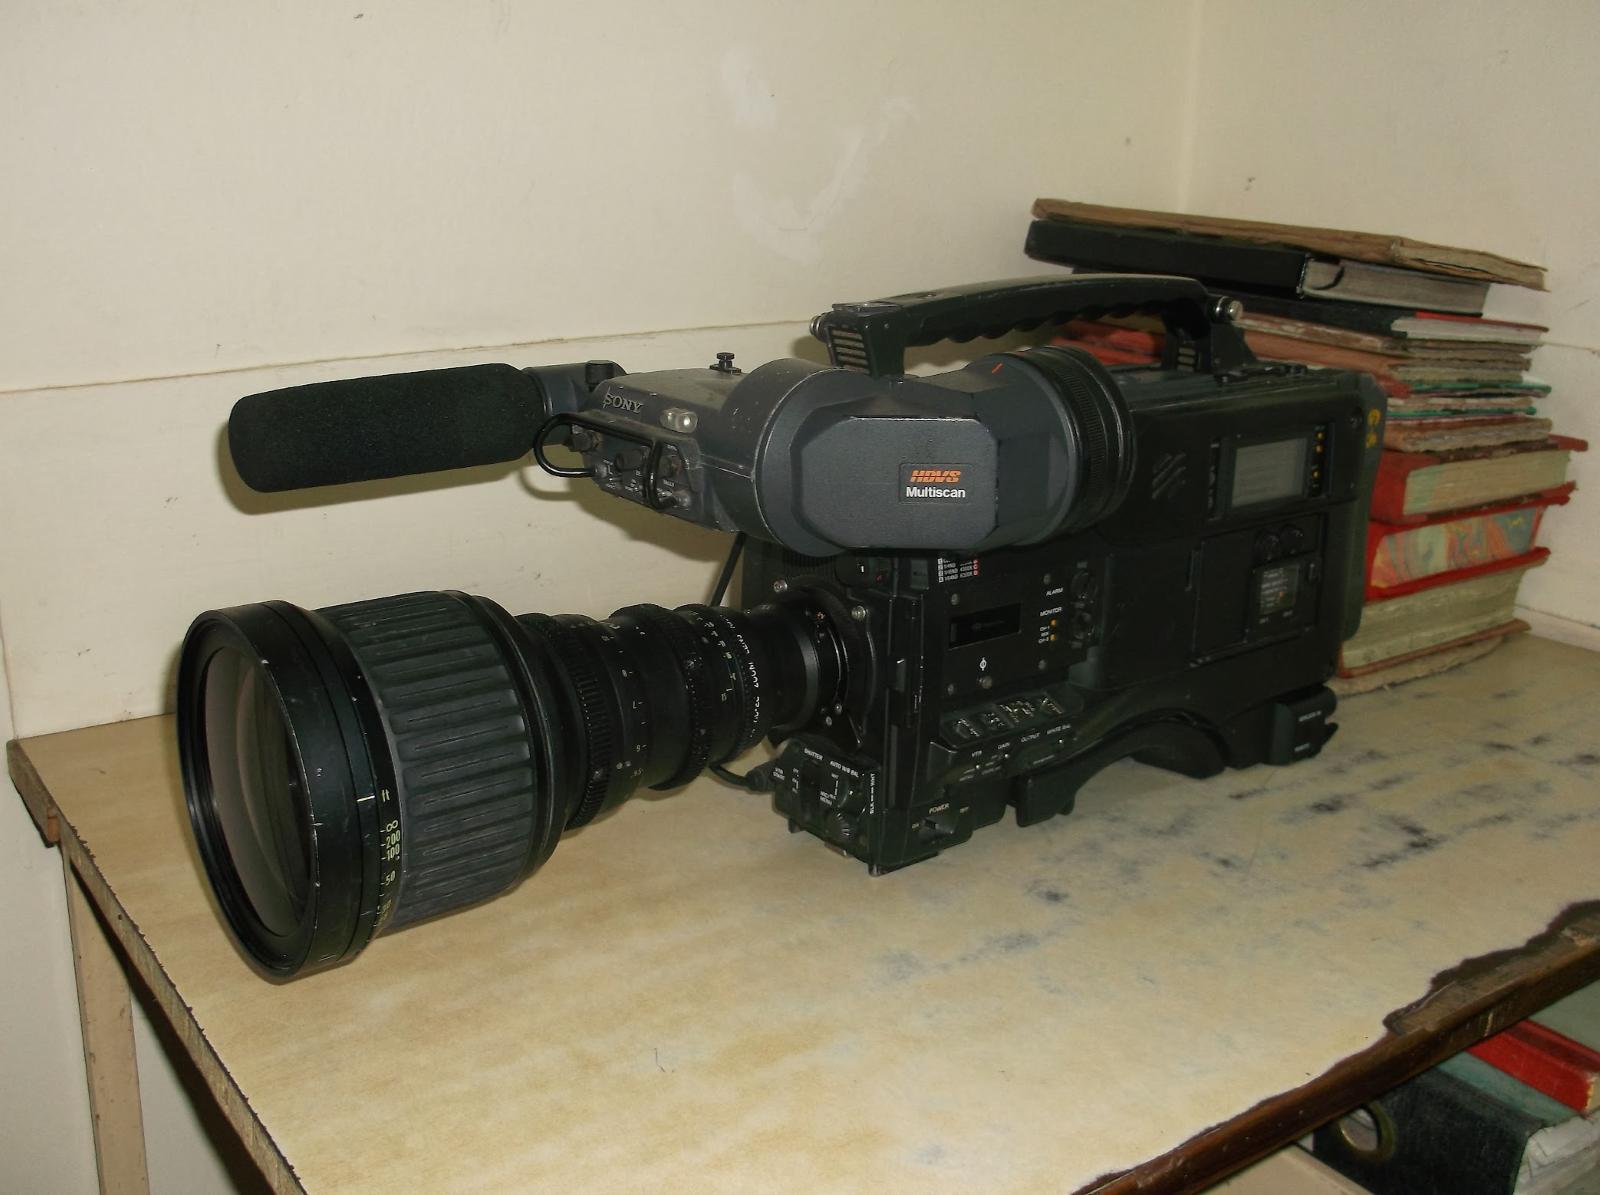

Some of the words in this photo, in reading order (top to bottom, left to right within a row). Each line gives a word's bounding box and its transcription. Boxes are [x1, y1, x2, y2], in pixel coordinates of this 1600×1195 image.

[602, 391, 645, 414] SONY
[909, 469, 962, 484] HDVS
[905, 486, 966, 499] Multiscan
[1039, 606, 1062, 617] MONITOR
[381, 788, 391, 804] ft
[928, 802, 951, 816] POWER
[385, 829, 401, 849] 200
[386, 843, 401, 862] 100
[384, 870, 396, 886] 50
